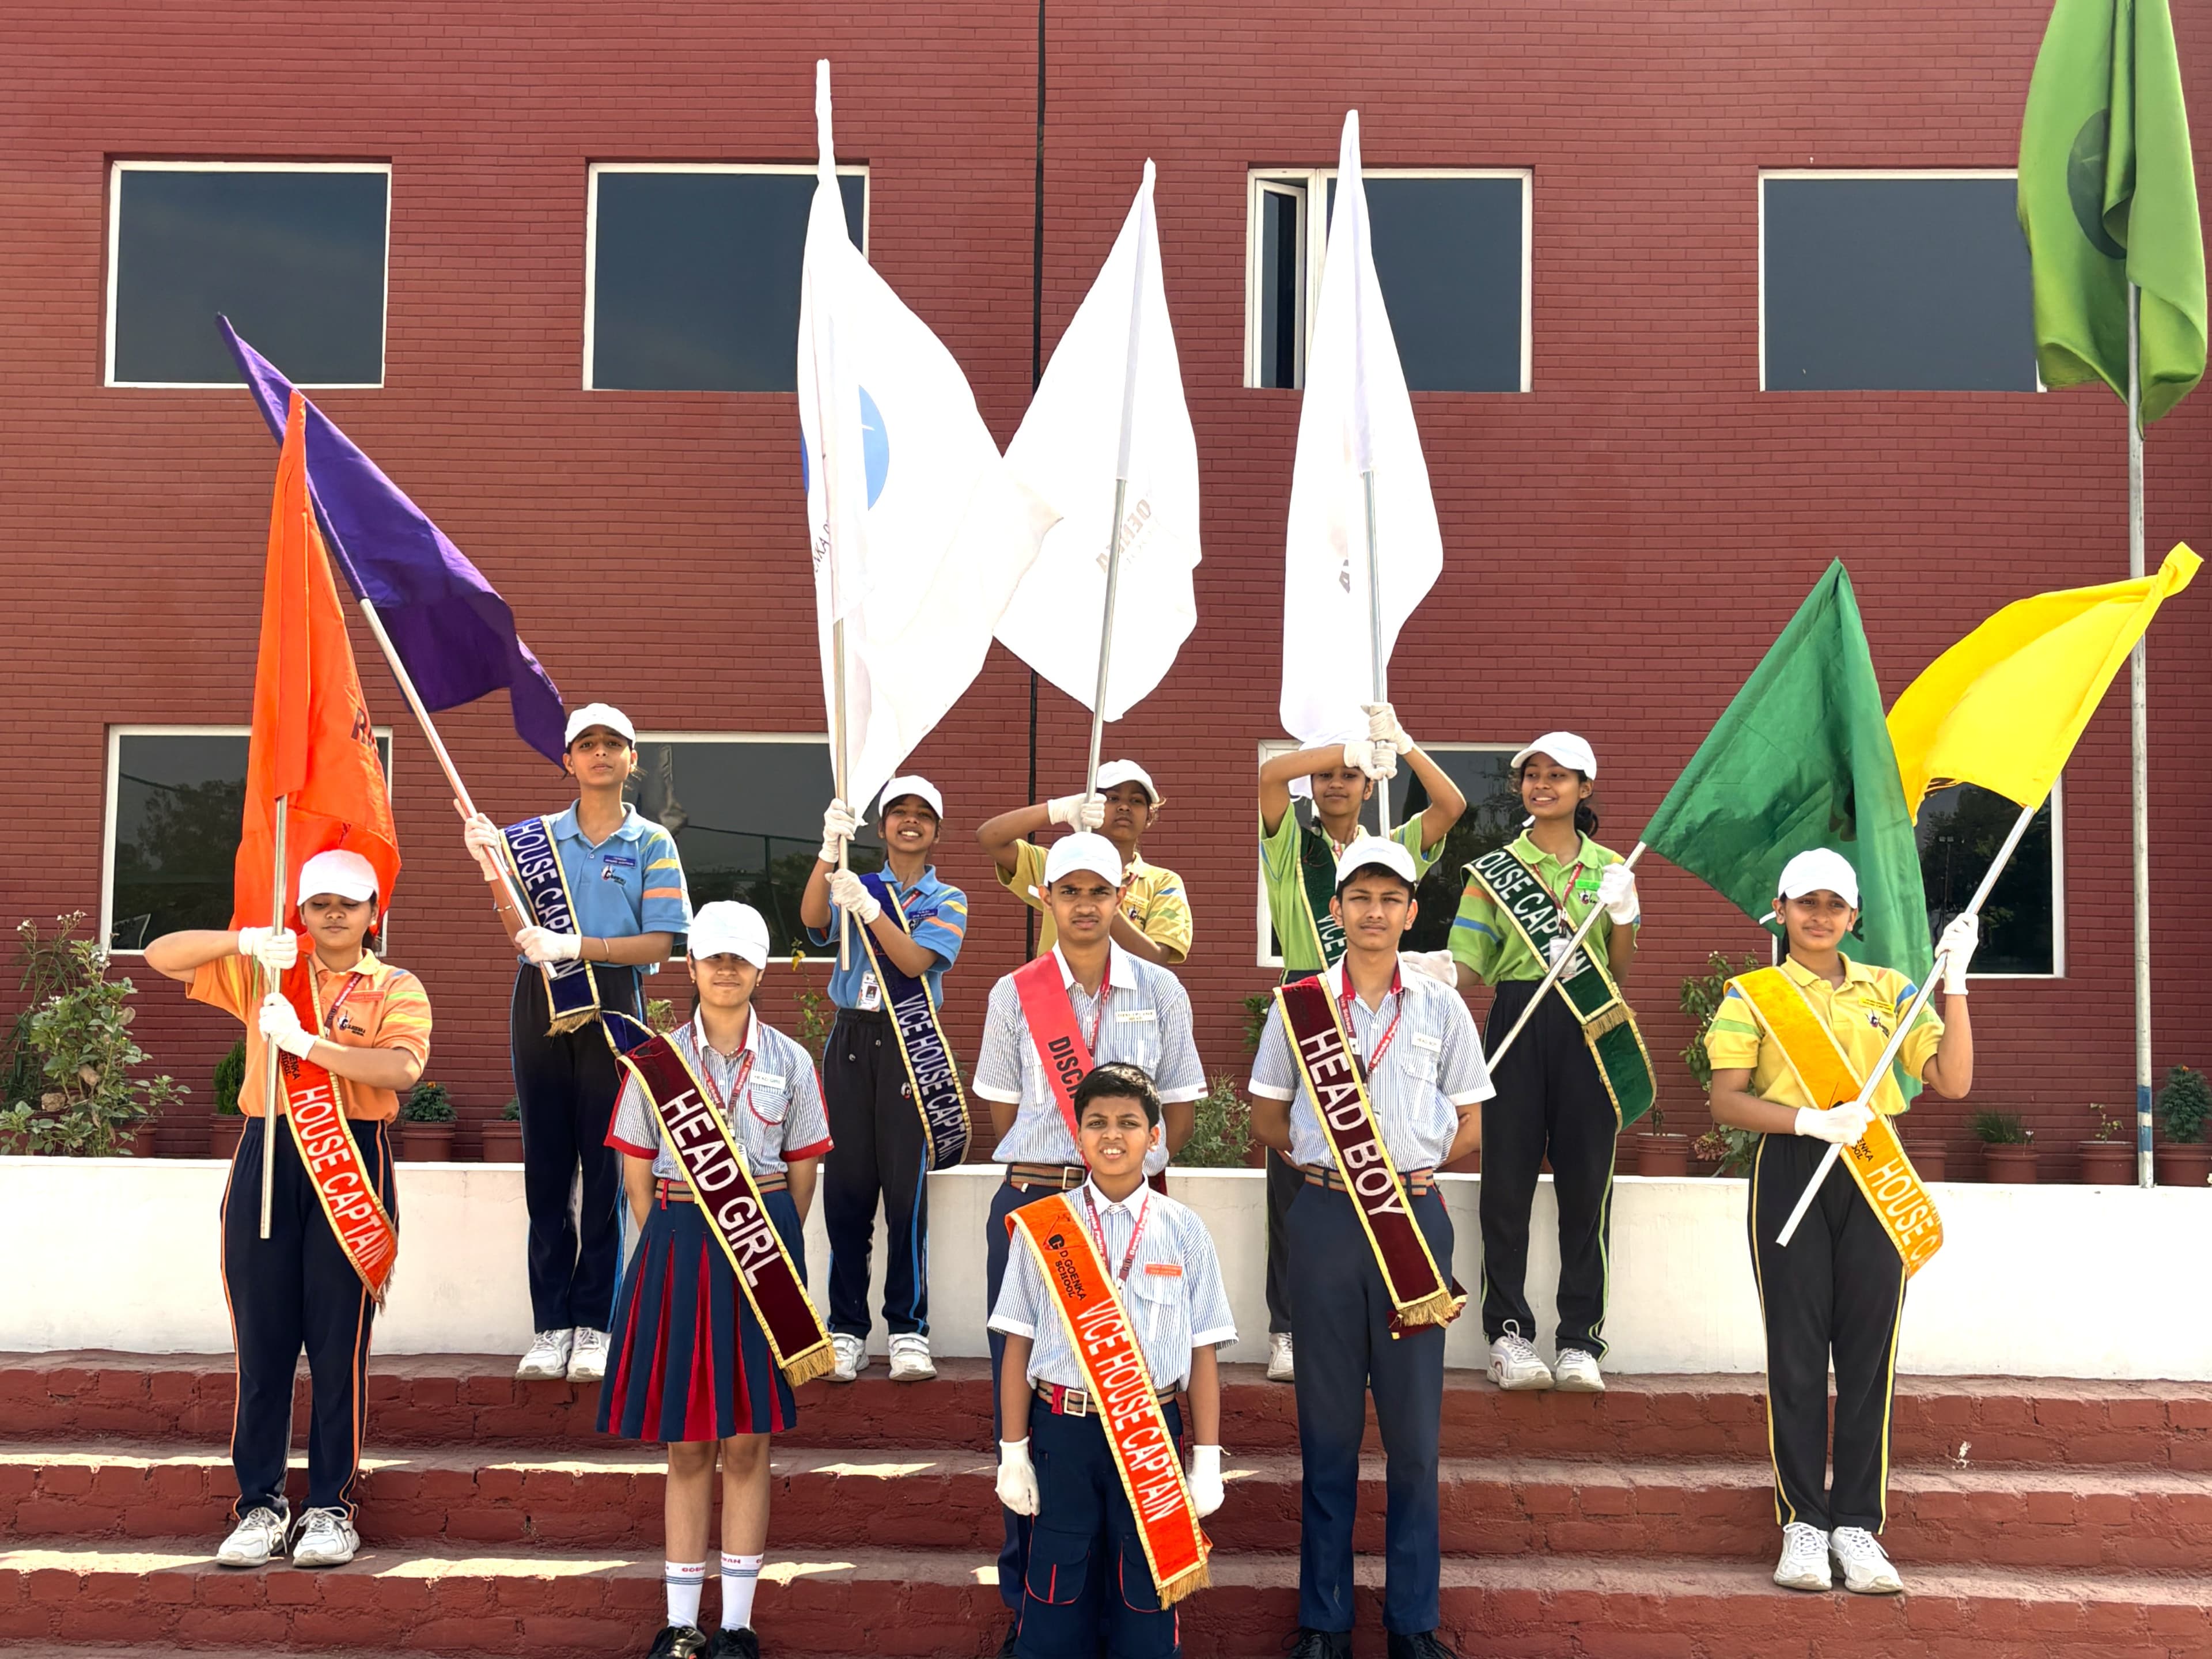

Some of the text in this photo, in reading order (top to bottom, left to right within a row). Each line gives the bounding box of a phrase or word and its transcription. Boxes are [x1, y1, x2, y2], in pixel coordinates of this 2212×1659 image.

[507, 821, 558, 892] HOUSE
[1471, 849, 1534, 900] OUSE
[894, 993, 967, 1162] VICE HOUSE CAPTAIN
[1300, 1028, 1406, 1215] HEAD BOY
[290, 1085, 391, 1270] HOUSE CAPTAIN
[660, 1088, 781, 1288] HEAD GIRL
[1866, 1157, 1934, 1246] HOUSE
[1055, 1260, 1075, 1298] SCHOOL
[1077, 1297, 1184, 1522] VICE HOUSE CAPTAIN
